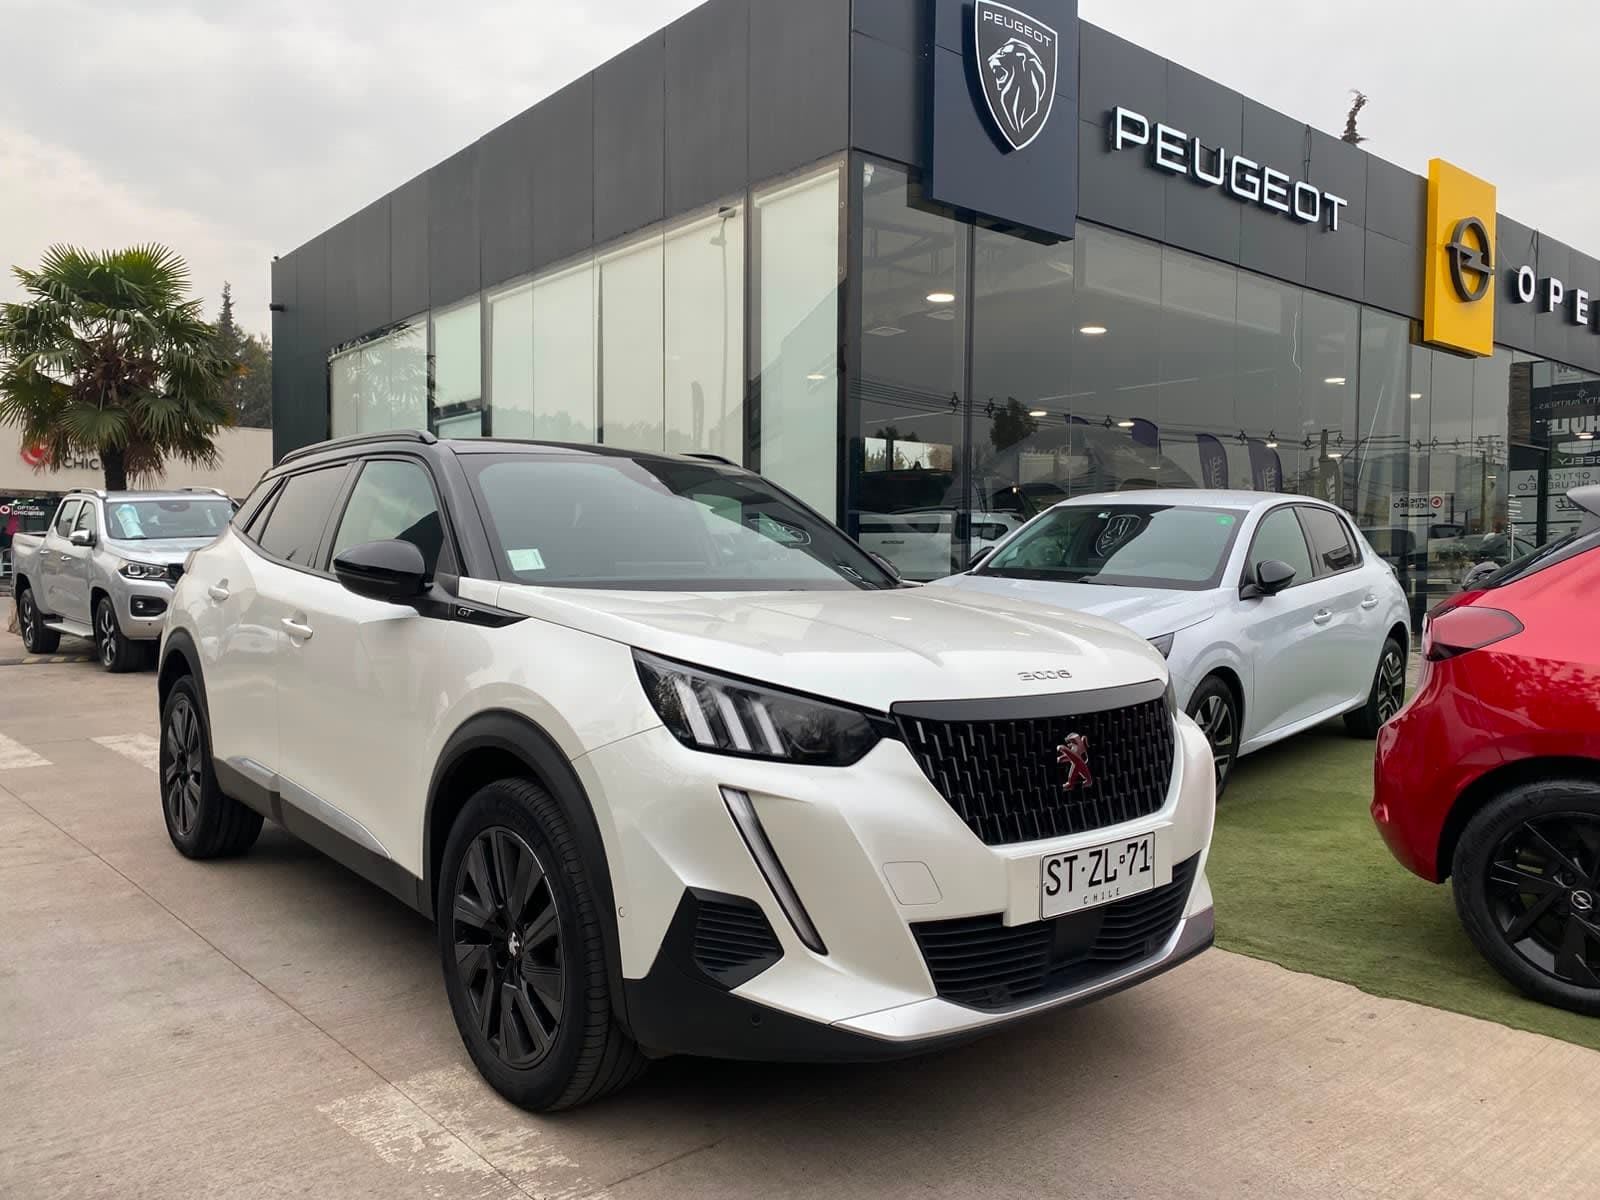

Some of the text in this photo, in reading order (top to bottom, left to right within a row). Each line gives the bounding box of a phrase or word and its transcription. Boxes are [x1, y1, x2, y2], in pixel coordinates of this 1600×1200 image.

[983, 10, 1052, 47] PEUGEOT
[1114, 106, 1347, 231] PEUGEOT
[1518, 264, 1600, 326] OPE
[457, 607, 475, 617] GT
[1083, 887, 1120, 905] CHILE
